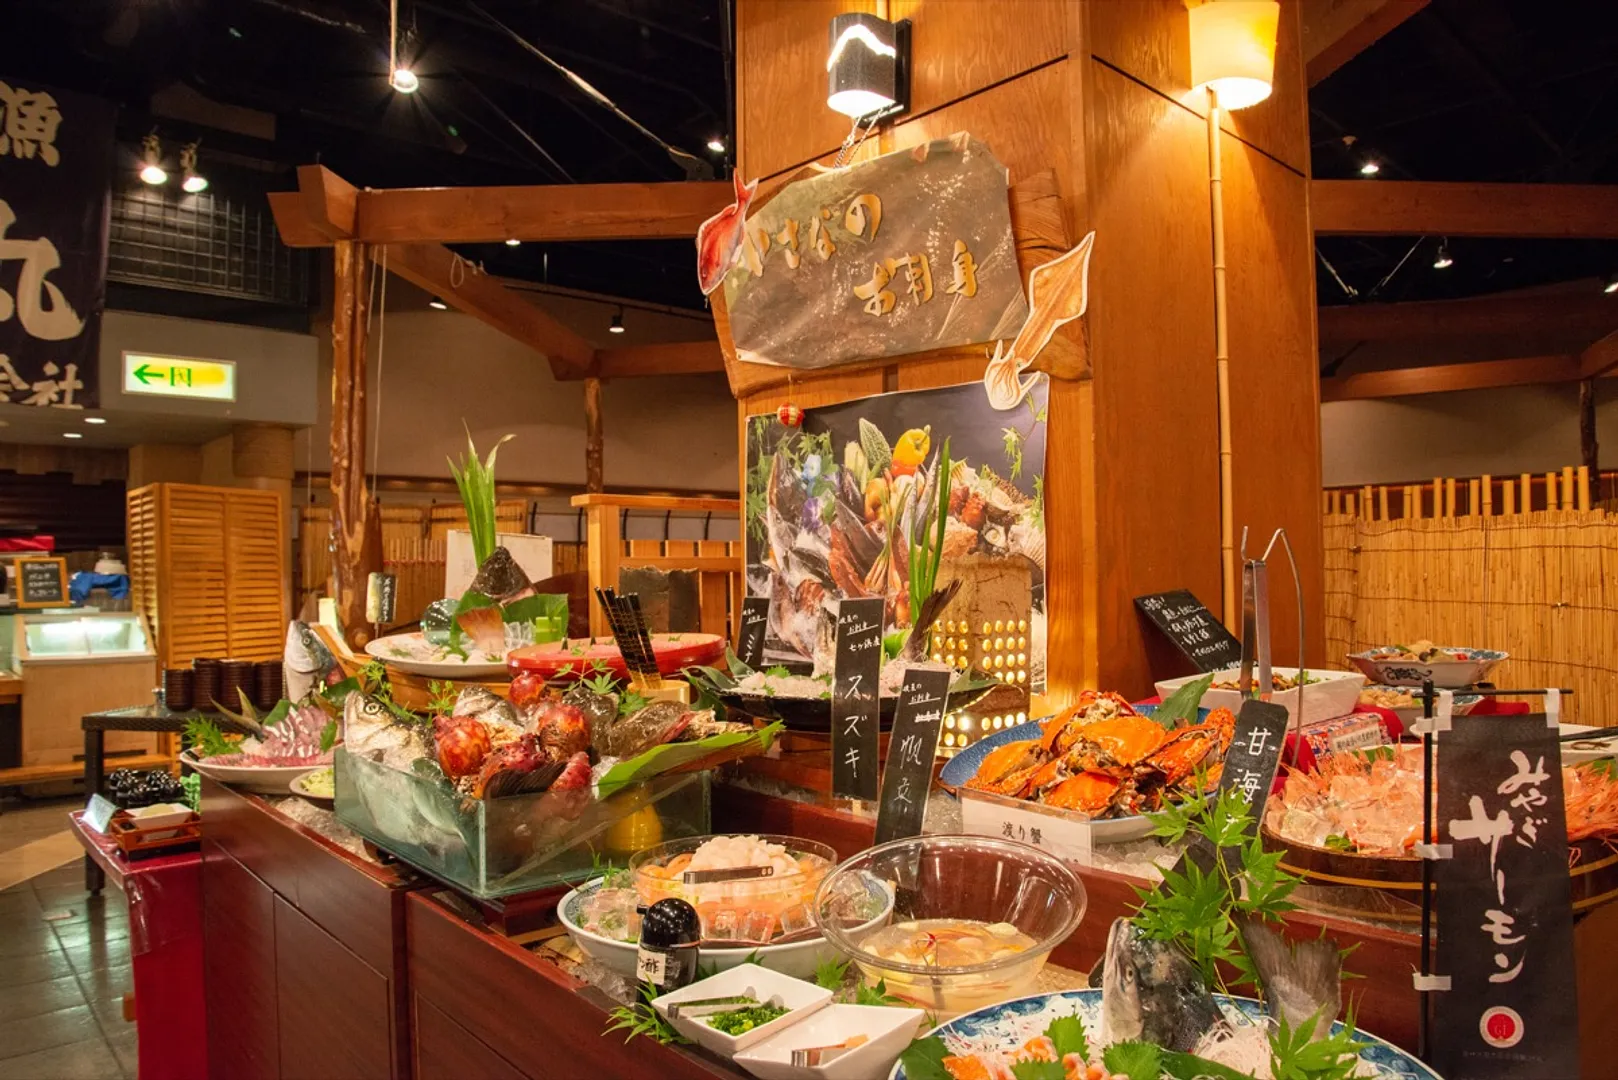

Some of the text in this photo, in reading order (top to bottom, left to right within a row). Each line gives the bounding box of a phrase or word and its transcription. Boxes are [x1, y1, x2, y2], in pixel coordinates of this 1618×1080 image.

[853, 239, 978, 317] お刺身
[844, 675, 868, 778] スズキ
[1002, 821, 1042, 844] 渡り蟹
[1497, 750, 1550, 849] みやぎ
[1449, 795, 1526, 983] サーモン
